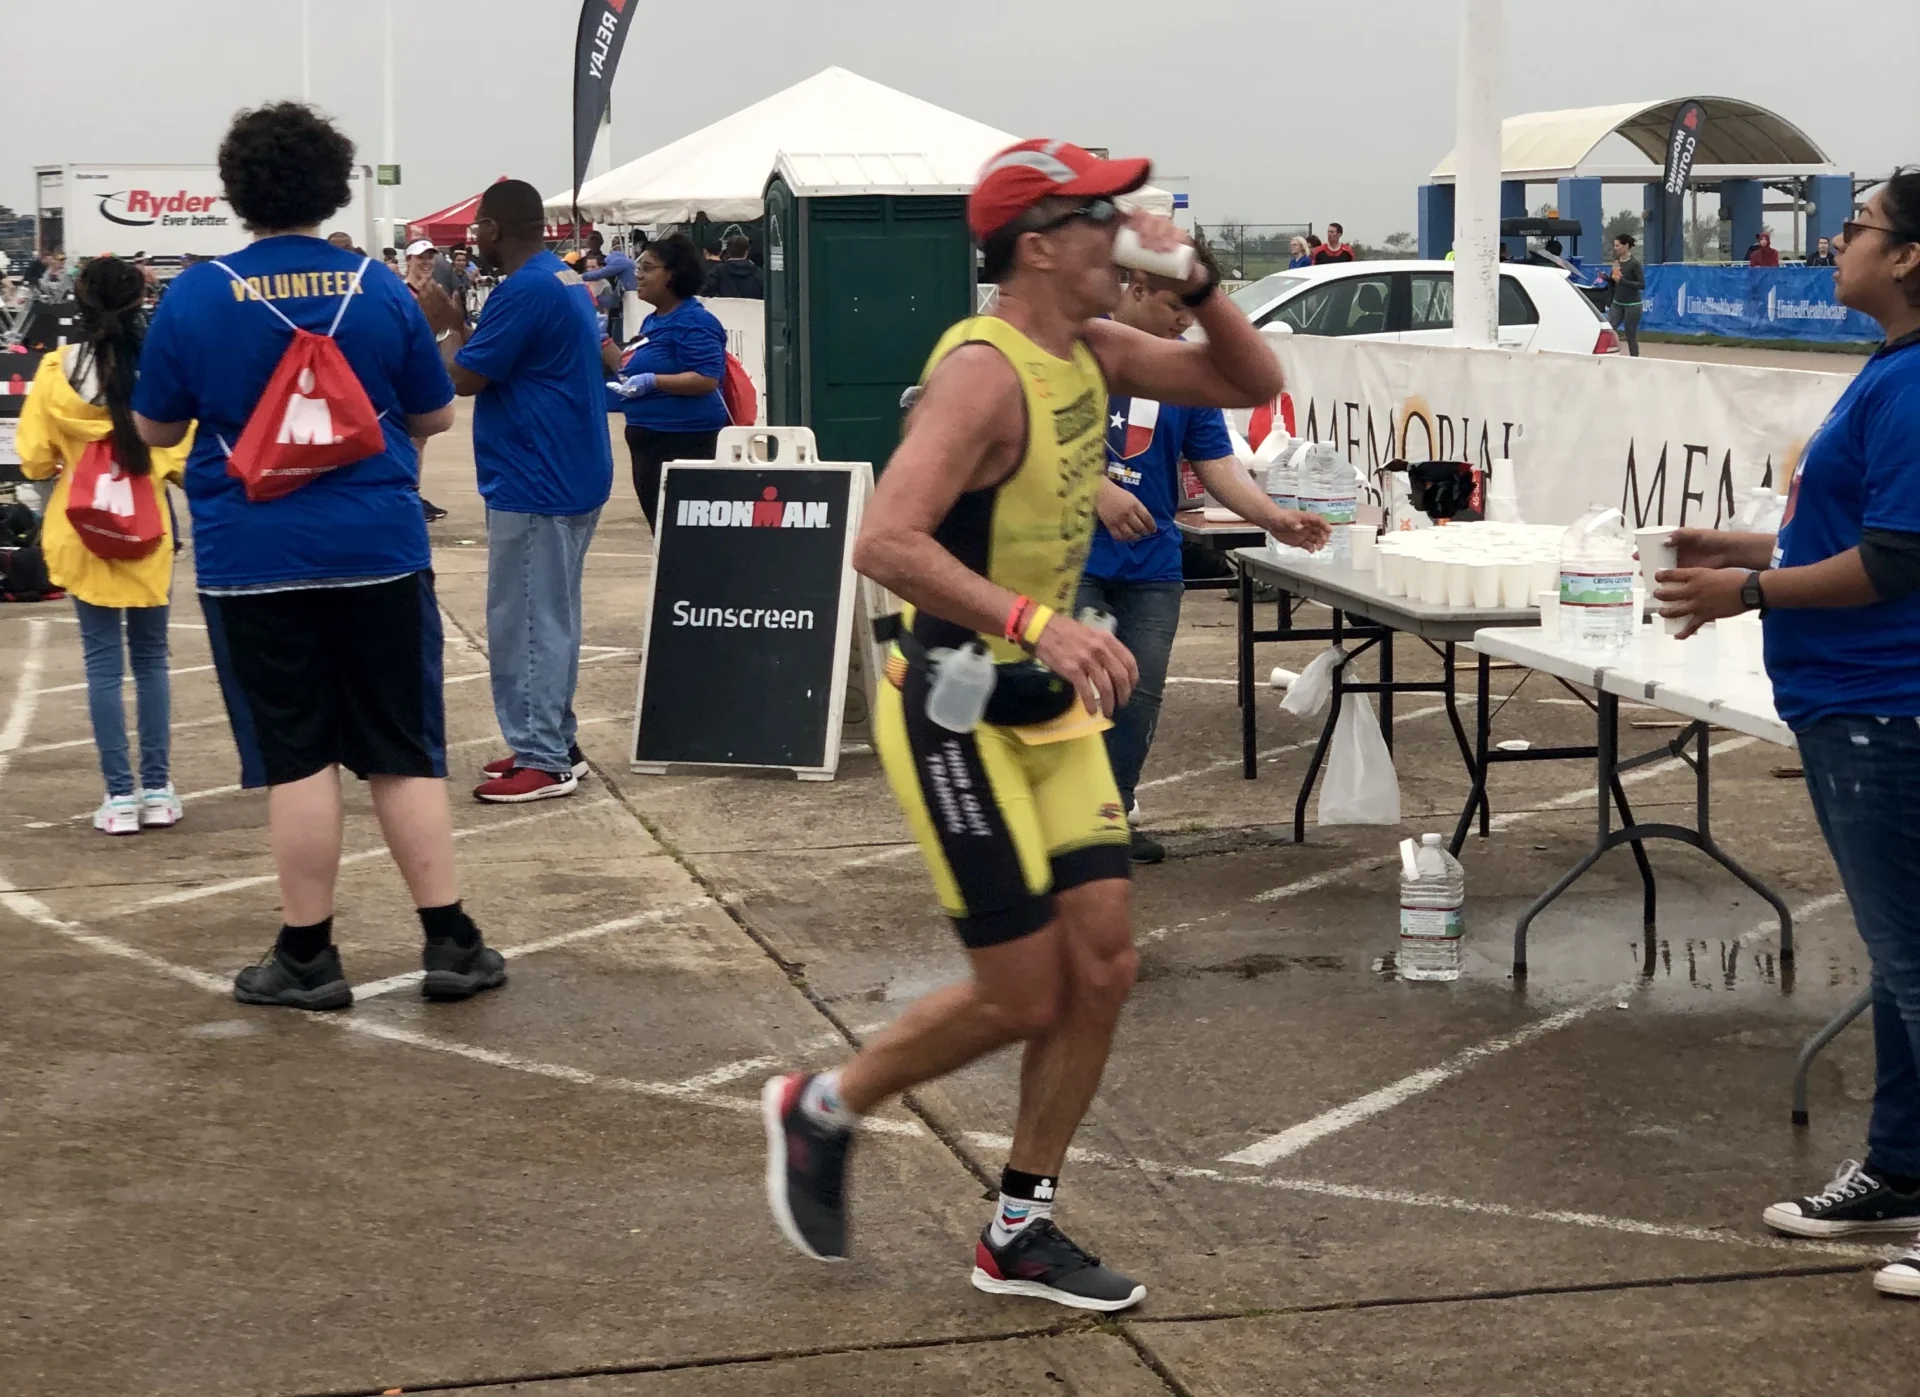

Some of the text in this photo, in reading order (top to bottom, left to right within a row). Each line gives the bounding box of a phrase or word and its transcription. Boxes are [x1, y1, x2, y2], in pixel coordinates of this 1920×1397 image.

[127, 190, 217, 218] Ryder
[162, 215, 188, 226] Ever
[230, 272, 364, 302] VOLUNTEER
[1687, 295, 1745, 317] UnitedHealthcare
[1777, 299, 1847, 320] UnitedHealthcare
[676, 486, 829, 529] IRONMAN
[672, 600, 814, 630] Sunscreen
